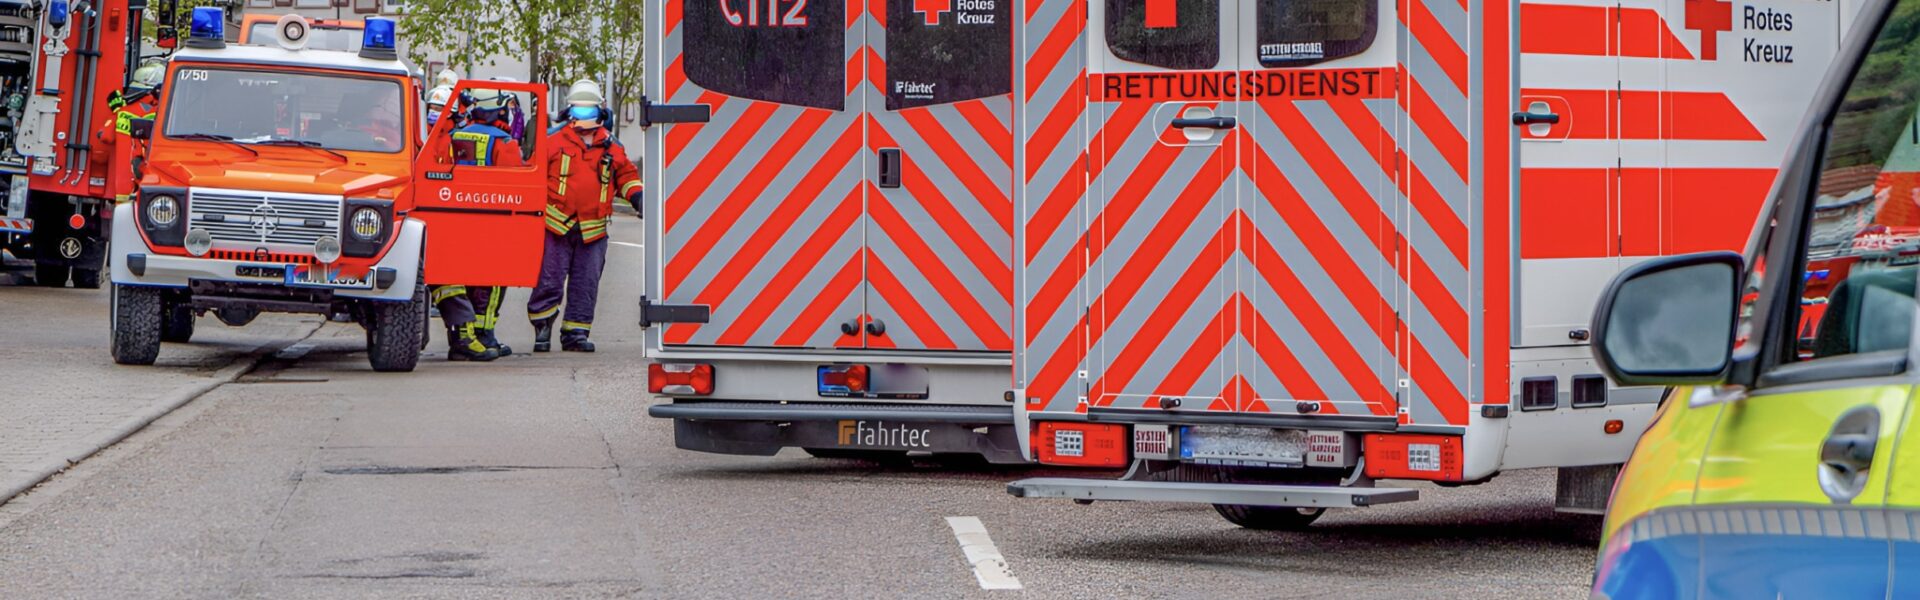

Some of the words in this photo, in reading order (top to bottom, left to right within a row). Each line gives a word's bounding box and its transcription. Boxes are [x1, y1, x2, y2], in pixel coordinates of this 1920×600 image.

[957, 0, 995, 10] Rotes
[957, 12, 995, 24] Kreuz
[1743, 6, 1793, 32] Rotes
[1743, 38, 1794, 63] Kreuz
[1103, 71, 1380, 99] RETTUNGSDIENST
[455, 192, 522, 205] GAGGENAU
[857, 420, 931, 448] fahrtec
